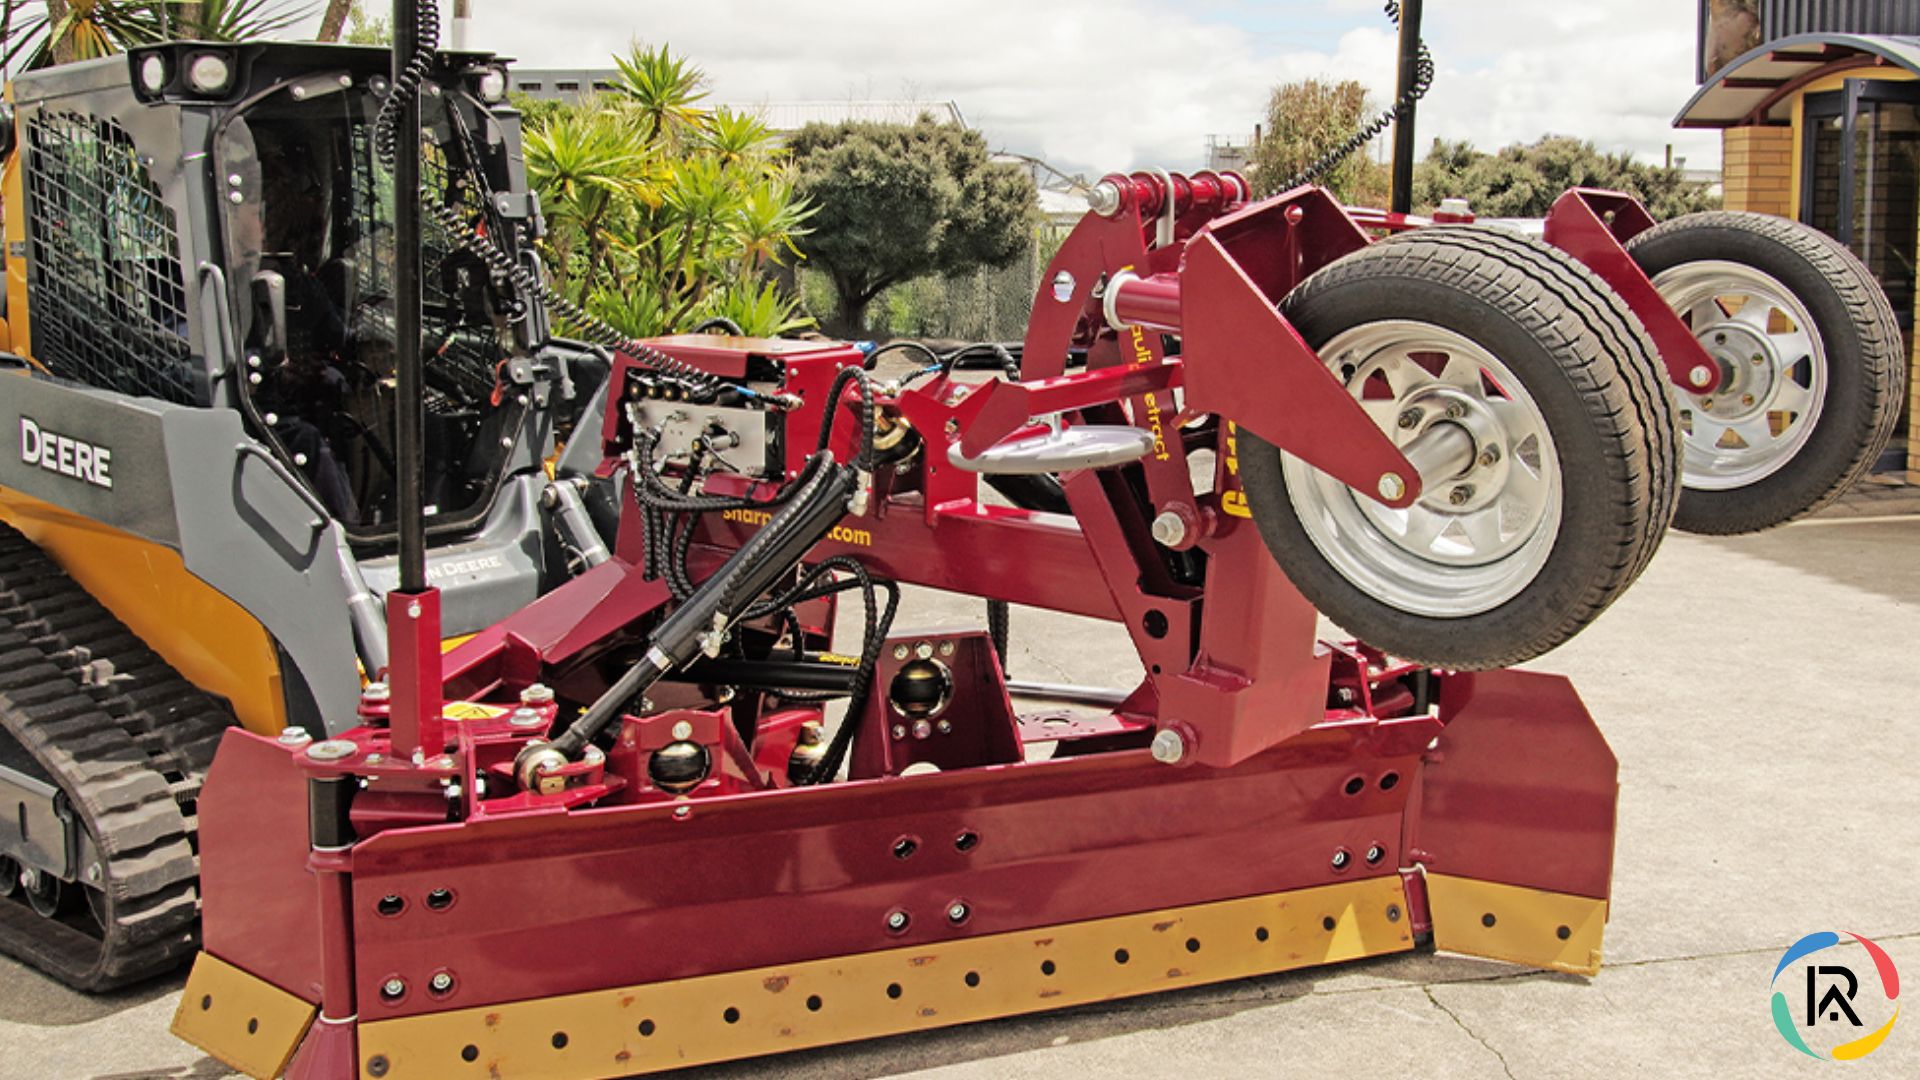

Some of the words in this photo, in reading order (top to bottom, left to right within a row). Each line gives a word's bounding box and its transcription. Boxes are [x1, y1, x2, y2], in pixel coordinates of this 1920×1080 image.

[19, 416, 113, 489] DEERE
[1144, 392, 1170, 461] etract
[442, 556, 502, 576] DEERE
